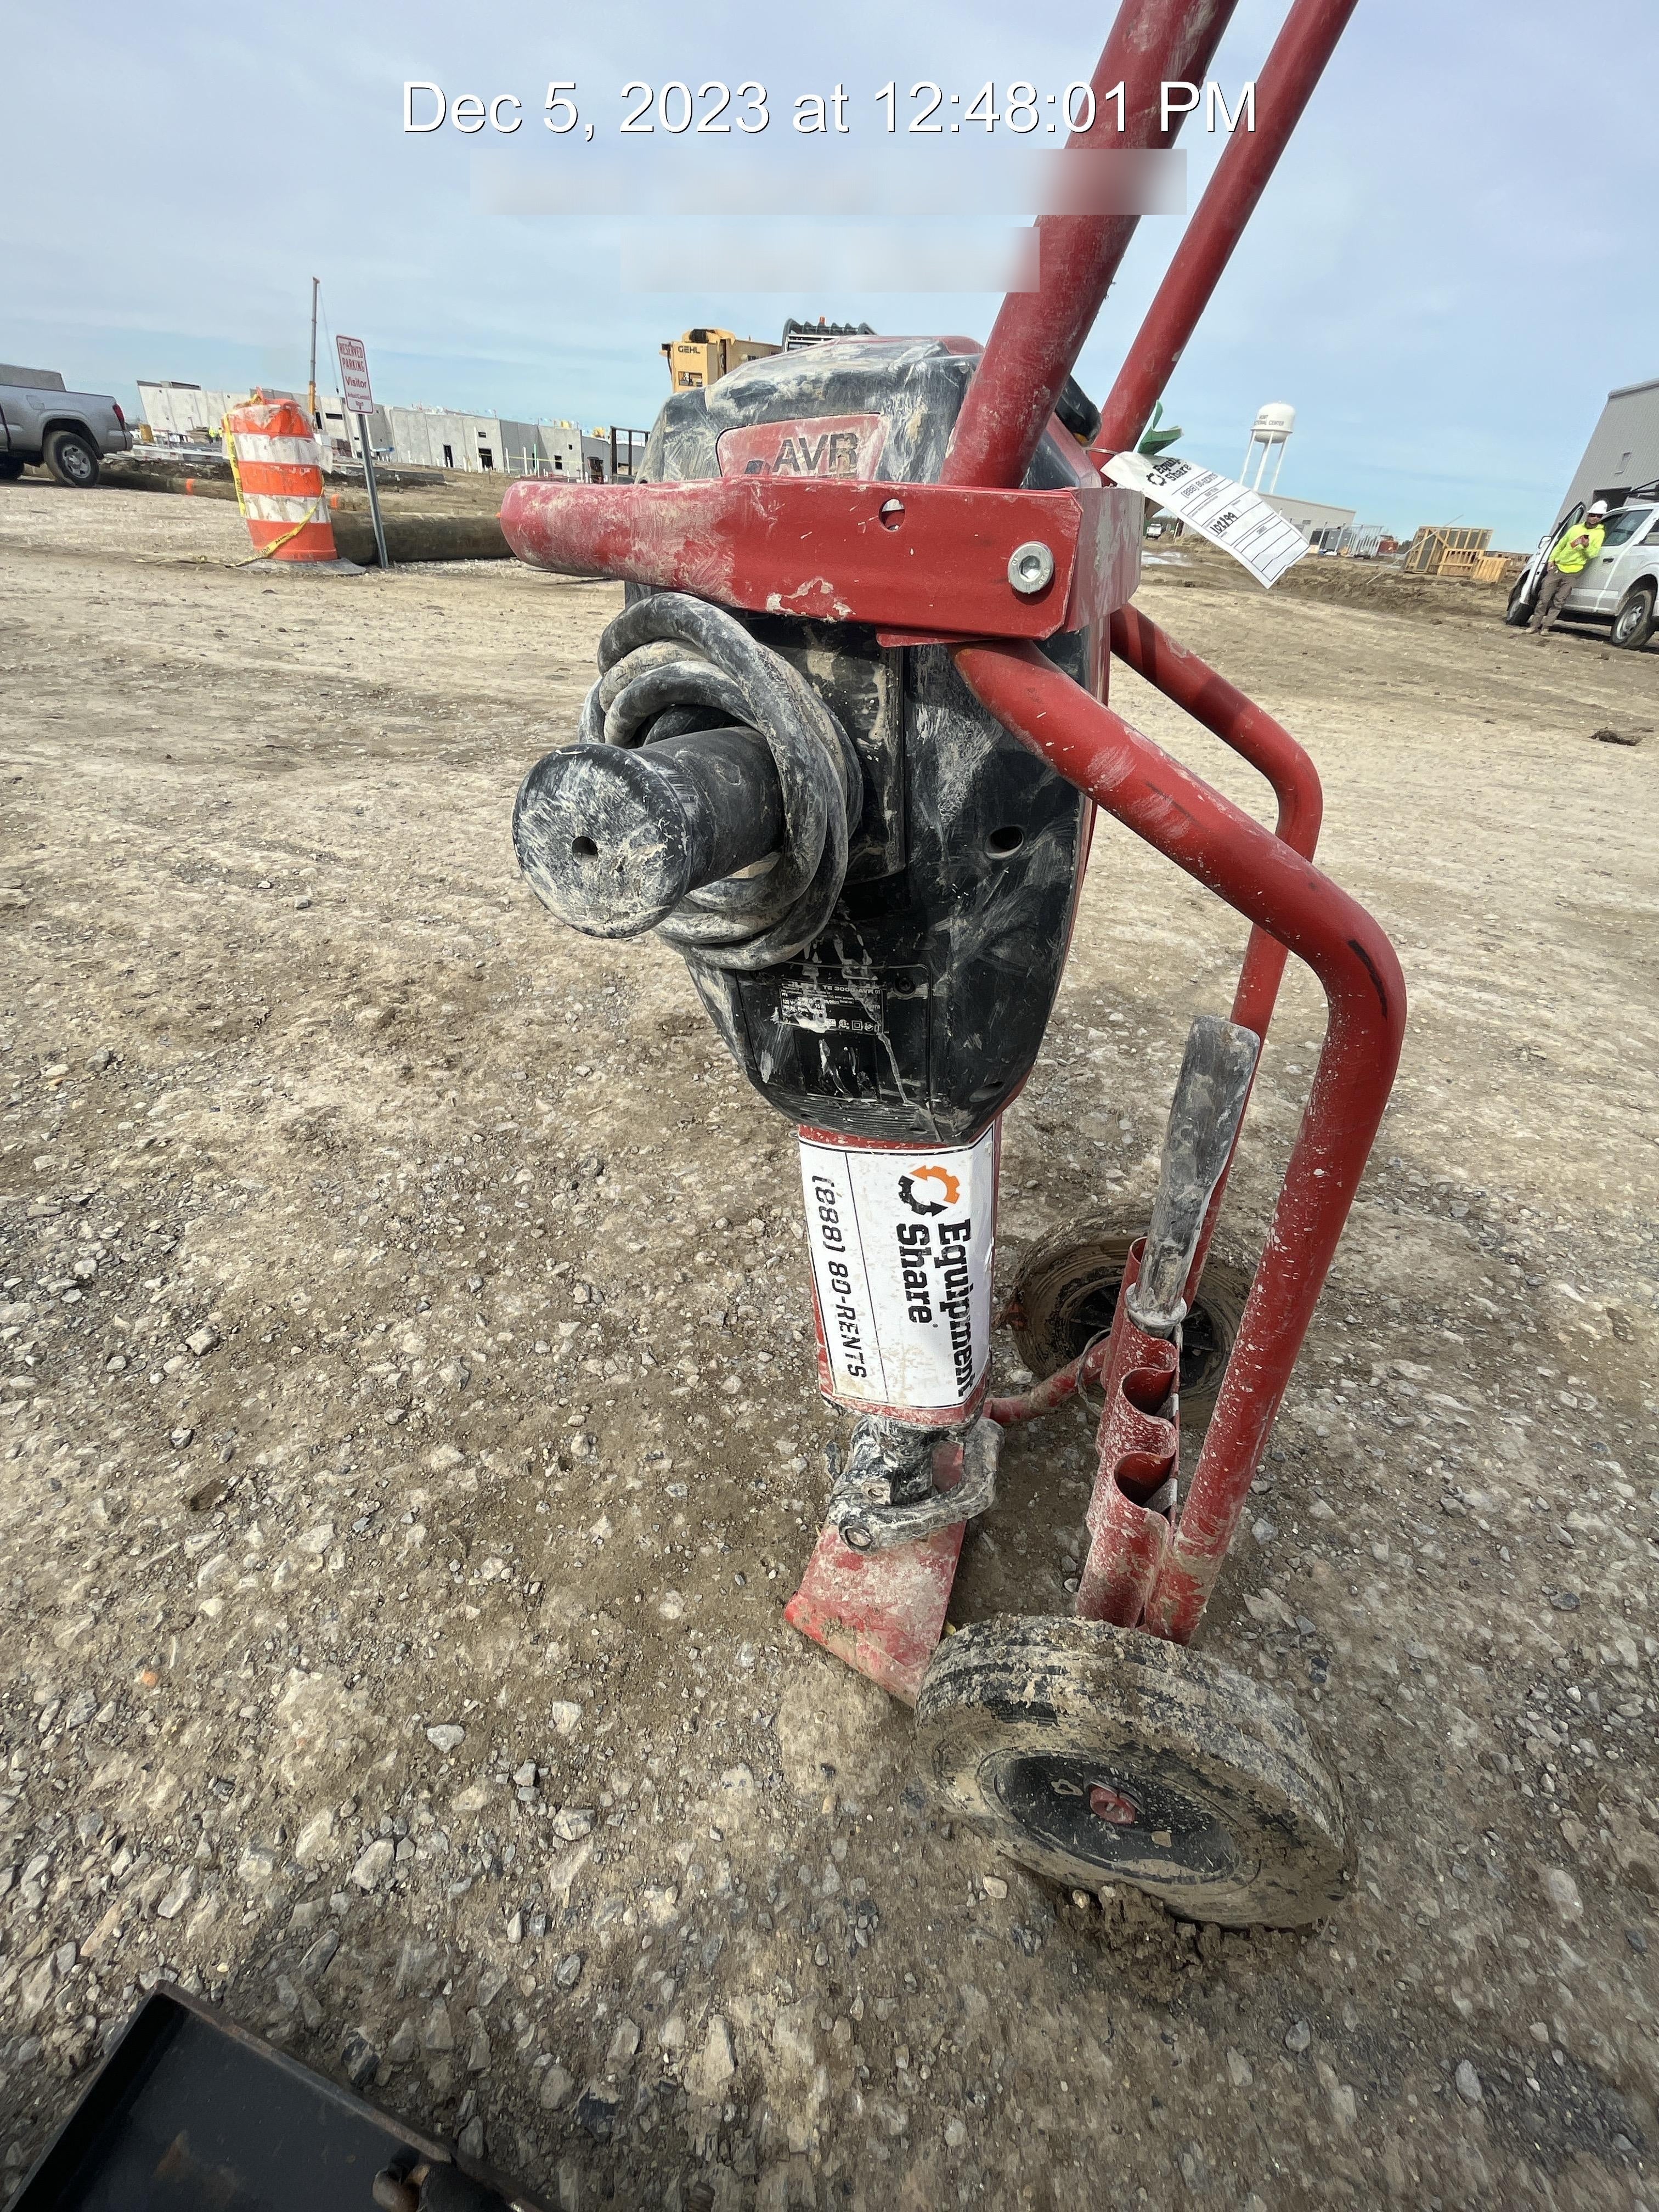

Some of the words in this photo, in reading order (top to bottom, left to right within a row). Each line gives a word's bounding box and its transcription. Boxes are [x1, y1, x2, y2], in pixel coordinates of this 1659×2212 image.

[340, 343, 363, 358] RESERVED
[678, 346, 701, 354] GEHL
[342, 358, 365, 372] PARKING
[345, 376, 367, 388] Visitor
[771, 432, 859, 473] AVR
[1165, 464, 1192, 481] Share
[812, 1175, 845, 1253] (888)
[896, 1223, 933, 1324] Share
[828, 1261, 867, 1379] 80-RENTS
[933, 1218, 975, 1398] Equipment
